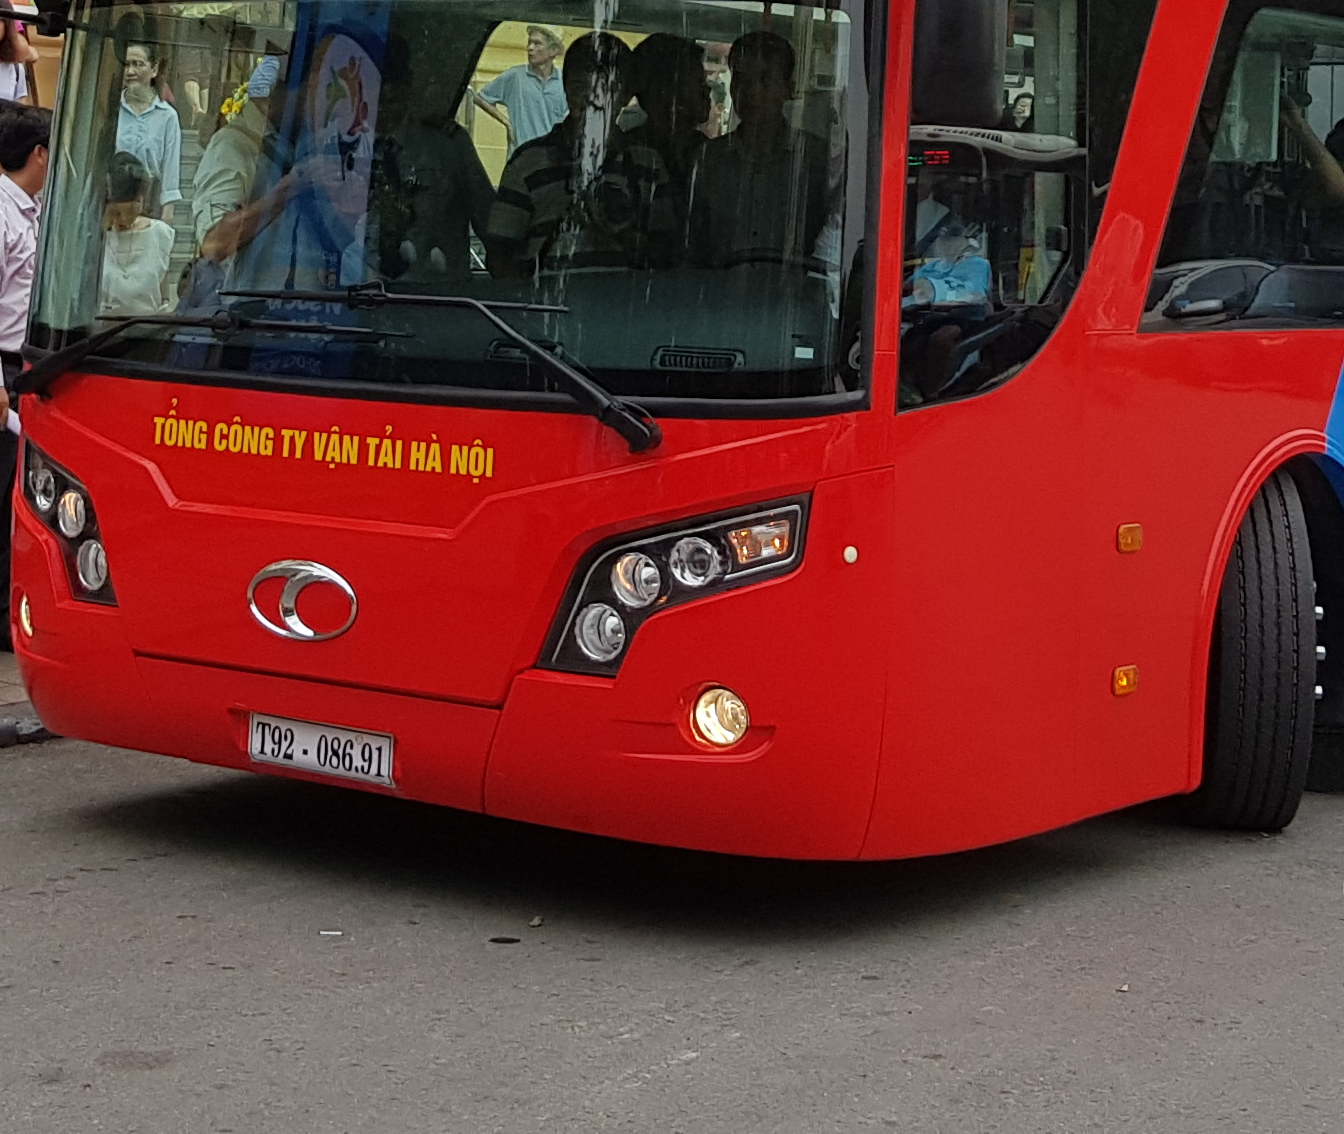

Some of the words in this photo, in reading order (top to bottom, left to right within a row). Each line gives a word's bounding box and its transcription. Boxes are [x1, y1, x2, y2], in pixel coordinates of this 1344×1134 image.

[153, 398, 208, 449] TỔNG
[214, 416, 273, 456] CÔNG
[281, 428, 308, 459] TY
[314, 427, 359, 468] VẬN
[367, 426, 403, 468] TẢI
[410, 433, 442, 472] HÀ
[450, 440, 494, 483] NỘI
